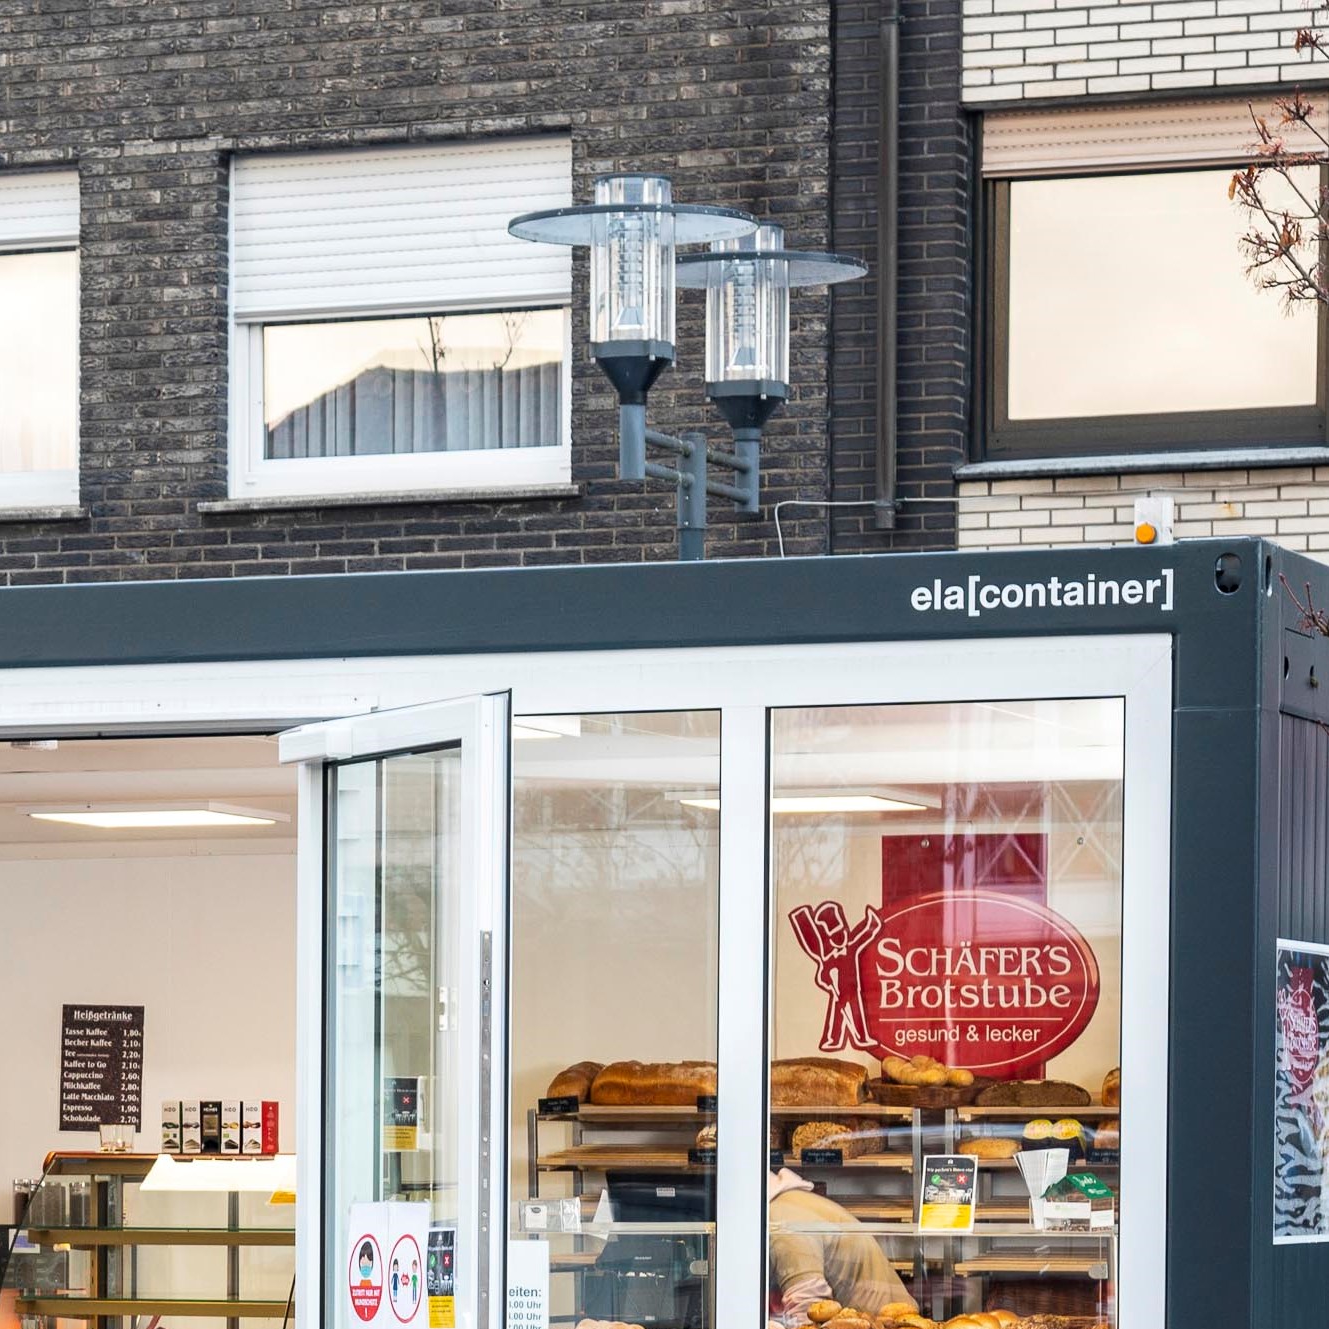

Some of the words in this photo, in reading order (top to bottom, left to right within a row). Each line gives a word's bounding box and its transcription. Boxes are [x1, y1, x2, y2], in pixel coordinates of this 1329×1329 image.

[911, 569, 1173, 617] ela[container]
[879, 978, 1071, 1008] Brotstube
[73, 1009, 133, 1021] Heißgetränke
[65, 1028, 84, 1036] Tasse
[86, 1028, 108, 1036] Kaffee
[895, 1025, 959, 1045] gesund
[966, 1025, 979, 1042] &
[985, 1024, 1041, 1042] lecker
[91, 1039, 112, 1047] Kaffee
[64, 1060, 86, 1068] Kaffee
[63, 1071, 104, 1080] Cappuccino
[63, 1081, 101, 1090] Milchkaffee
[63, 1092, 80, 1100] Latte
[62, 1103, 93, 1112] Espresso
[62, 1114, 101, 1122] Schokolade
[526, 1300, 541, 1309] Uhr
[526, 1312, 541, 1320] Uhr
